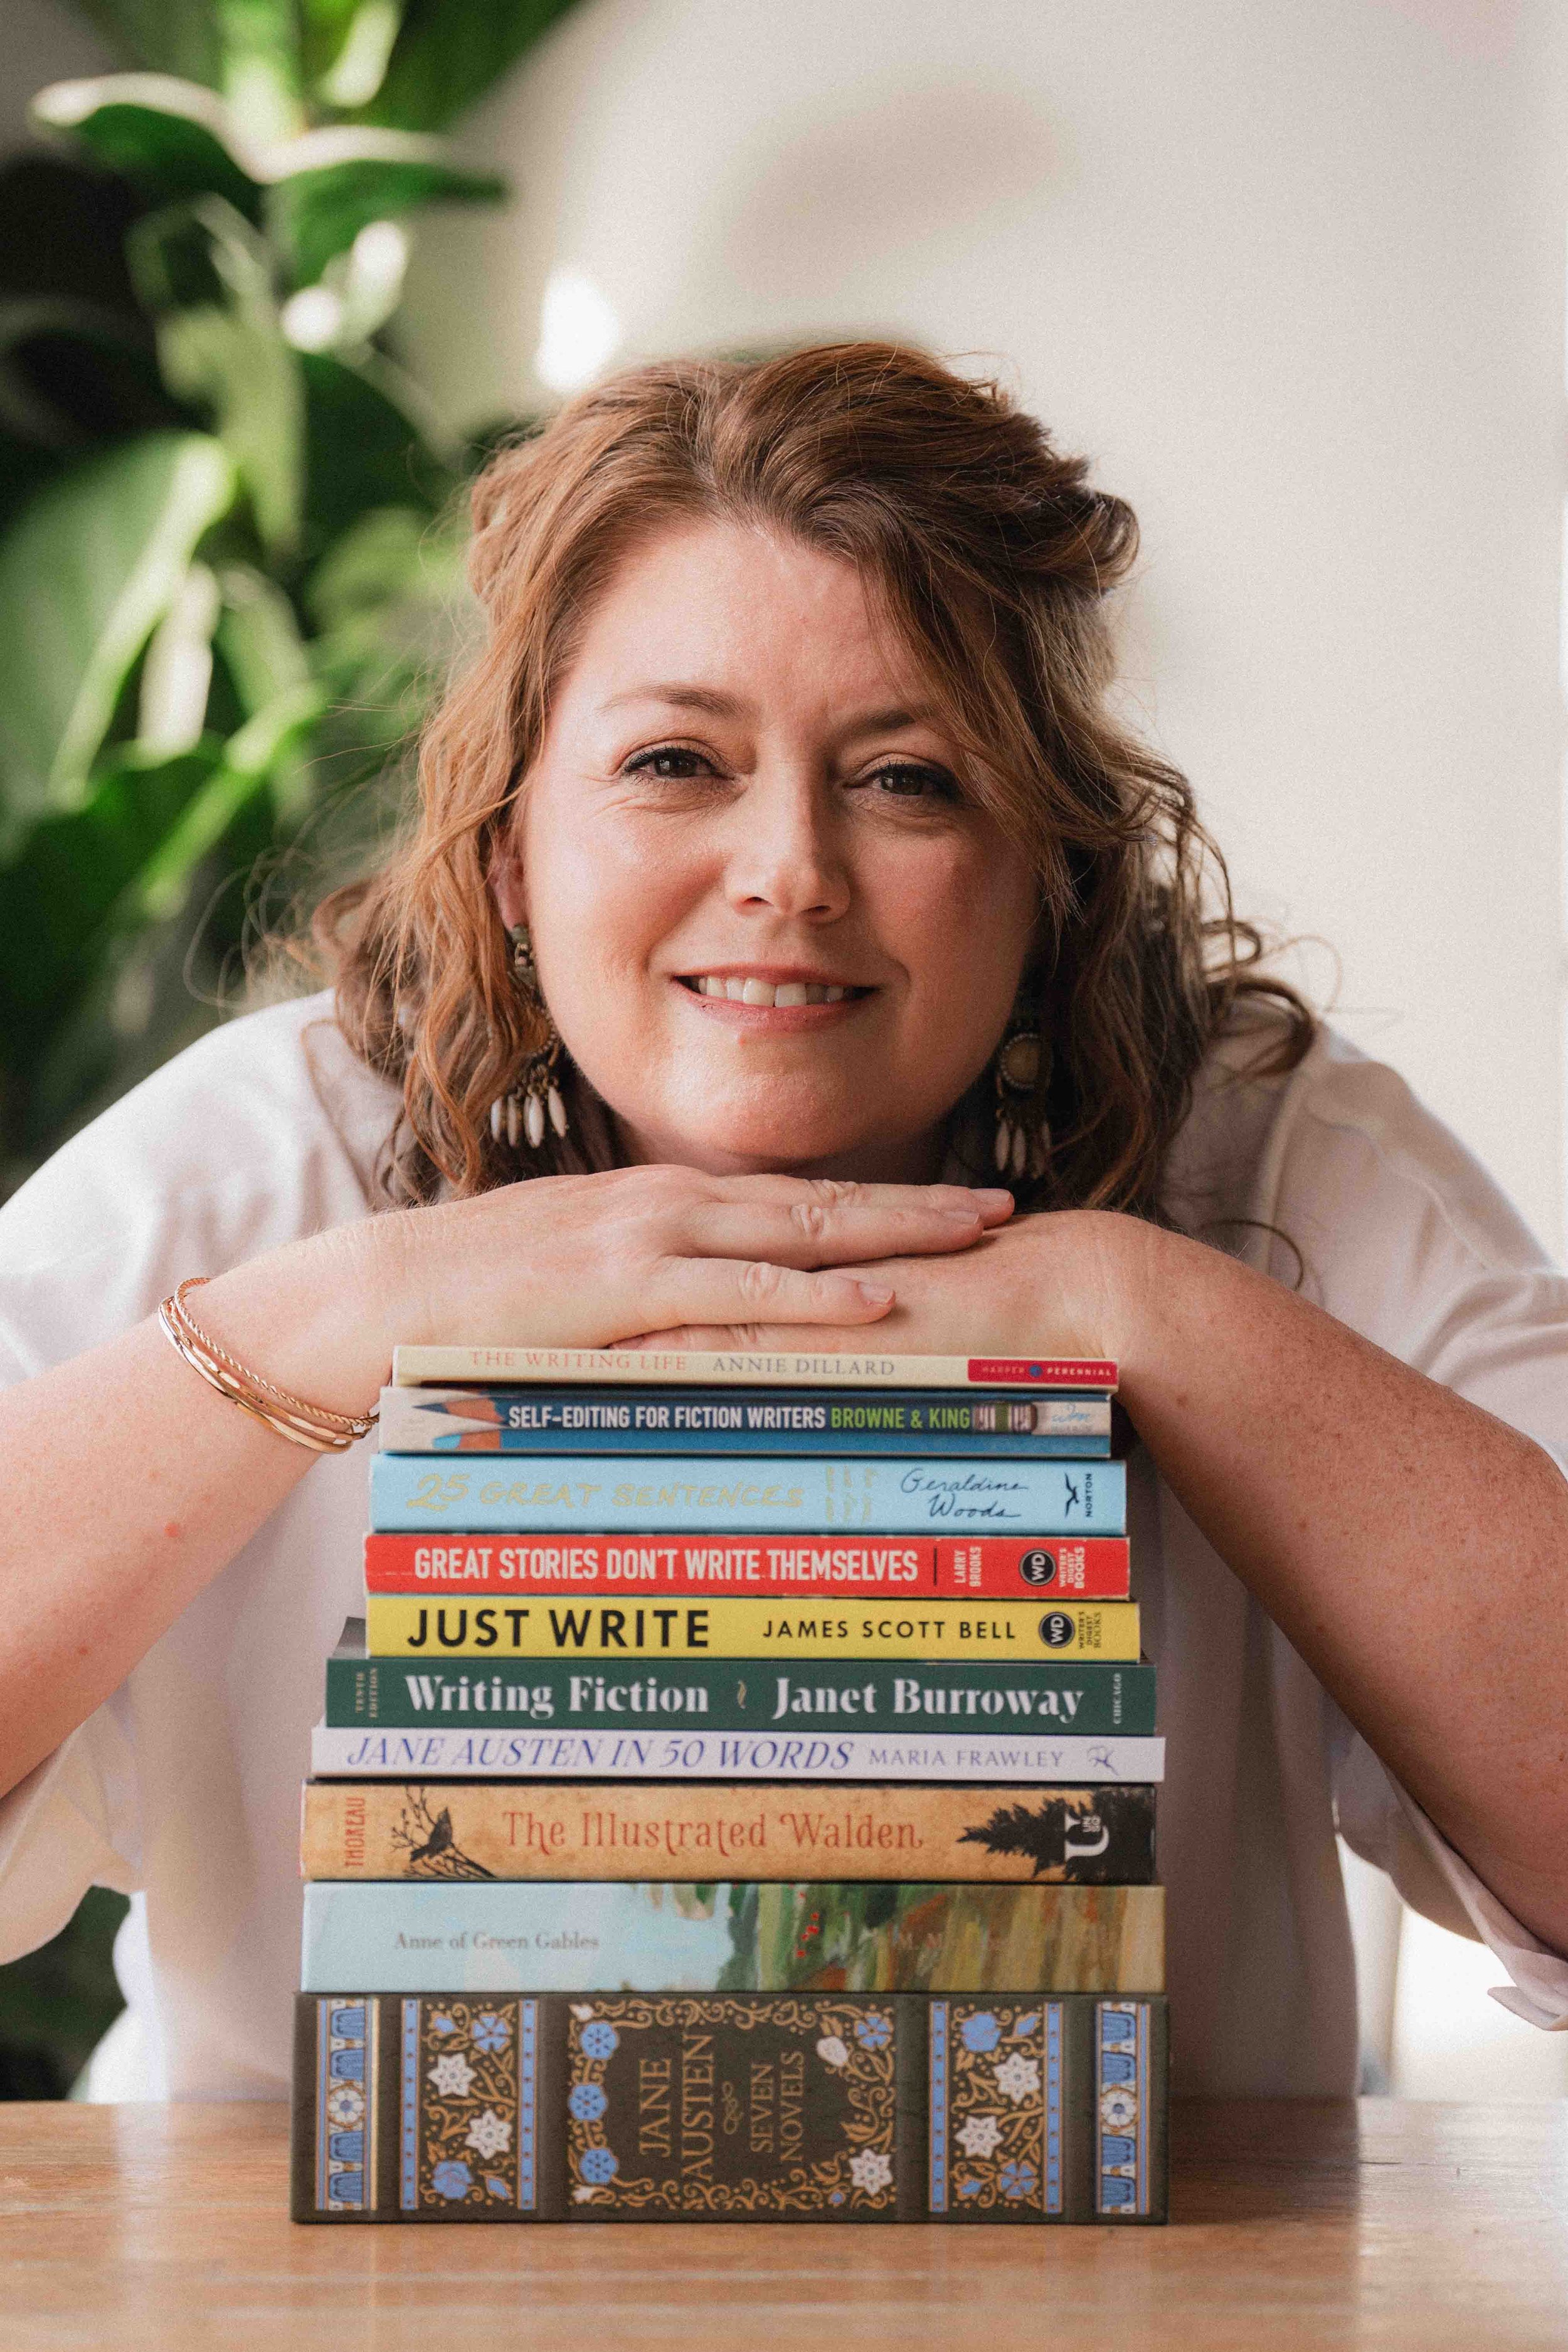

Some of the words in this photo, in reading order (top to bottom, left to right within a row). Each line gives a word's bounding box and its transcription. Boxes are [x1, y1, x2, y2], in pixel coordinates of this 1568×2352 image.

[470, 1351, 514, 1367] THE
[526, 1352, 631, 1370] WRITING
[639, 1354, 687, 1371] LIFE
[712, 1357, 787, 1374] ANNIE
[795, 1359, 896, 1376] DILLARD
[1046, 1367, 1112, 1377] PERENNIAL
[509, 1406, 629, 1429] SELF-EDITING
[635, 1406, 669, 1429] FOR
[674, 1406, 740, 1429] FICTION
[746, 1406, 825, 1429] WRITERS
[830, 1407, 906, 1430] BROWNE
[910, 1407, 923, 1429] &
[928, 1407, 970, 1430] KING
[406, 1473, 471, 1513] 25
[479, 1481, 603, 1508] GREAT
[612, 1481, 805, 1509] SENTENCES
[900, 1467, 1029, 1494] Geraldine
[1084, 1473, 1093, 1518] NORTON
[928, 1493, 1023, 1519] Woods
[414, 1547, 494, 1581] GREAT
[499, 1548, 599, 1581] STORIES
[607, 1548, 678, 1581] DON'T
[685, 1549, 760, 1581] WRITE
[767, 1549, 919, 1582] THEMSELVES
[954, 1549, 966, 1584] LARRY
[969, 1546, 982, 1587] BROOKS
[1030, 1553, 1046, 1582] WD
[1059, 1548, 1067, 1588] WRITER'S
[1074, 1546, 1085, 1589] BOOKS
[407, 1609, 529, 1648] JUST
[549, 1609, 709, 1648] WRITE
[763, 1620, 849, 1639] JAMES
[862, 1621, 946, 1639] SCOTT
[960, 1621, 1015, 1639] BELL
[1051, 1615, 1063, 1643] WD
[1093, 1611, 1102, 1648] BOOKS
[405, 1676, 555, 1720] Writing
[569, 1676, 709, 1713] Fiction
[771, 1677, 877, 1720] Janet
[893, 1678, 1084, 1724] Burroway
[347, 1737, 448, 1768] JANE
[452, 1737, 607, 1767] AUSTEN
[610, 1739, 654, 1767] IN
[659, 1739, 704, 1768] 50
[717, 1740, 855, 1770] WORDS
[869, 1749, 947, 1767] MARIA
[956, 1750, 1064, 1768] FRAWLEY
[344, 1796, 366, 1868] THOREAU
[502, 1811, 564, 1857] The
[581, 1811, 766, 1858] Illustrated
[394, 1932, 441, 1951] Anne
[449, 1932, 468, 1951] of
[472, 1934, 528, 1951] Green
[534, 1932, 600, 1951] Gables
[640, 2058, 671, 2158] JANE
[681, 2032, 714, 2183] AUSTEN
[750, 2063, 773, 2154] SEVEN
[780, 2051, 804, 2163] NOVELS
